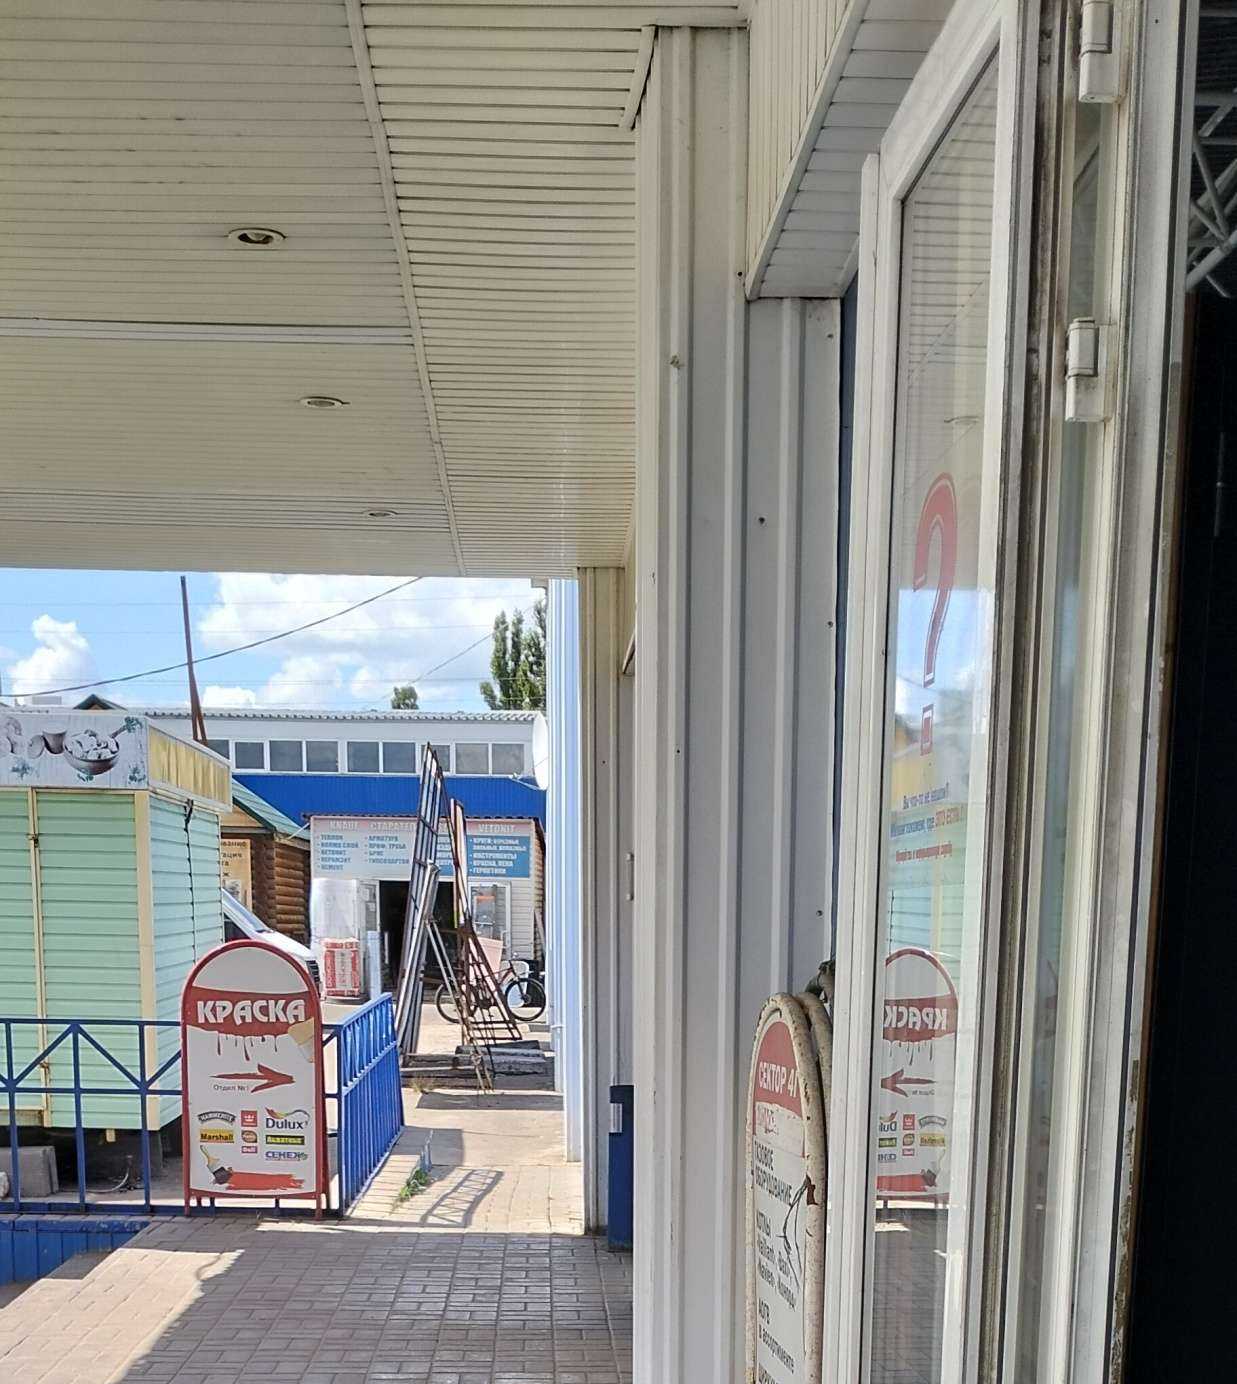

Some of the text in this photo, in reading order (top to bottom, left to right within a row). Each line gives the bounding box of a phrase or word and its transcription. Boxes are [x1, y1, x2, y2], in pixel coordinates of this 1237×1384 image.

[369, 821, 417, 831] СТАРАТЕЛ
[196, 999, 307, 1027] КРАСКА
[213, 1083, 236, 1093] Отдел
[758, 1061, 787, 1095] СЕКТОР
[265, 1117, 304, 1130] Dulux
[199, 1132, 235, 1142] Marshall
[754, 1164, 792, 1207] ОБОРУДОВАНИЕ
[762, 1325, 795, 1374] ассортименте
